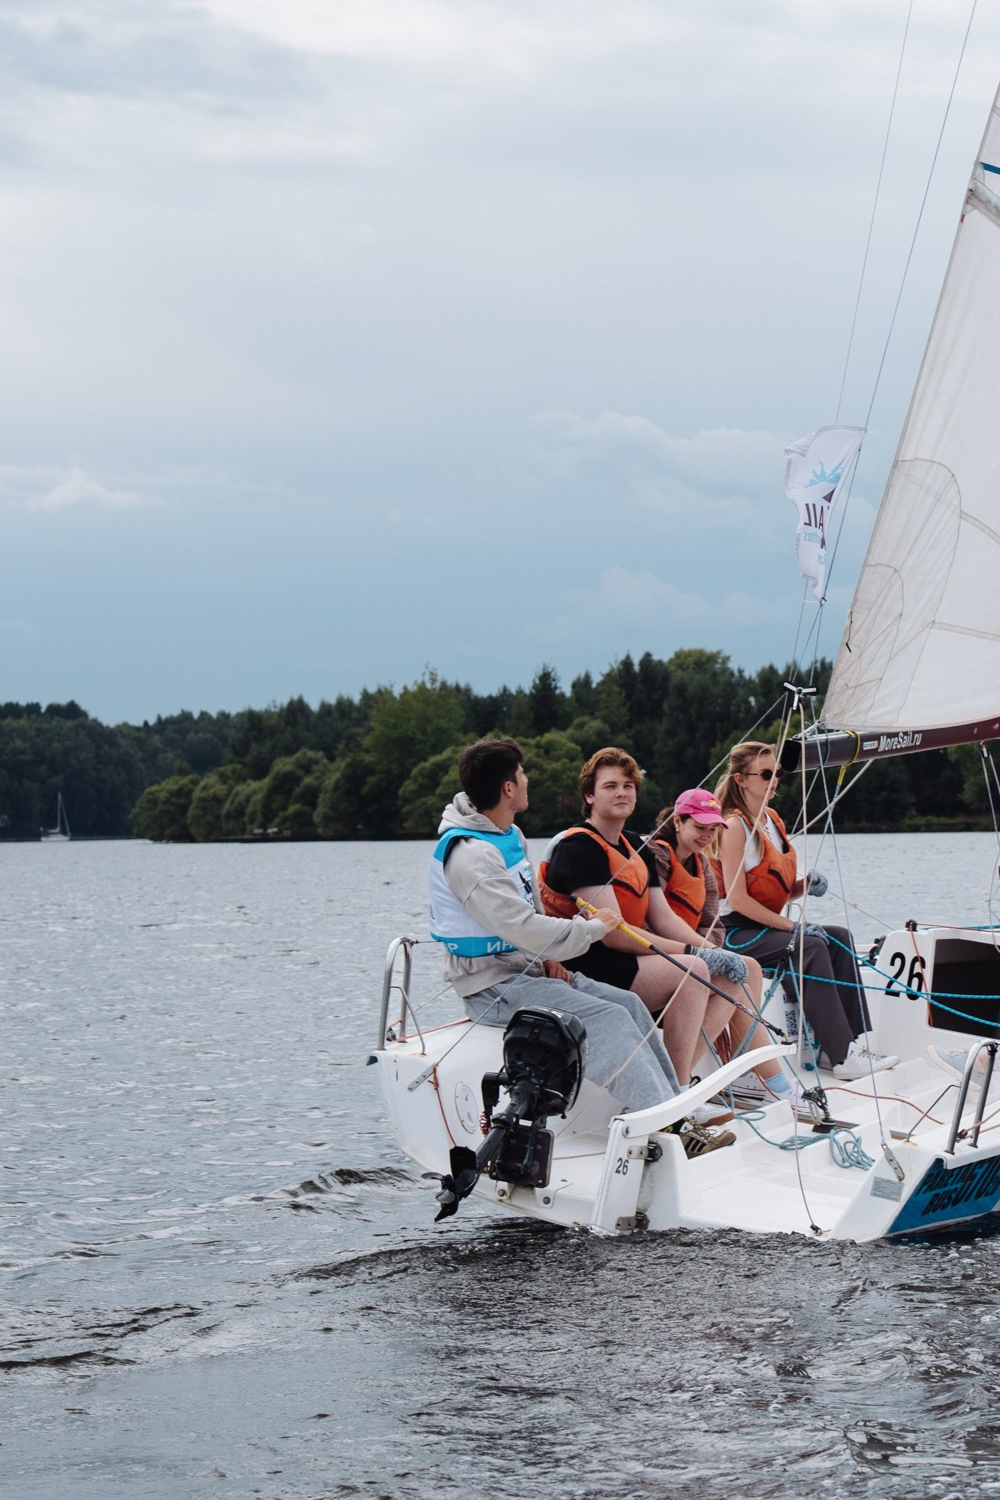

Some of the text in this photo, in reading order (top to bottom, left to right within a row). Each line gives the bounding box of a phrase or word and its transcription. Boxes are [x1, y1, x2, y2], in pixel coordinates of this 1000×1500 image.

[877, 730, 922, 752] MoreSail.ru
[885, 952, 926, 1001] 26
[615, 1157, 629, 1175] 26
